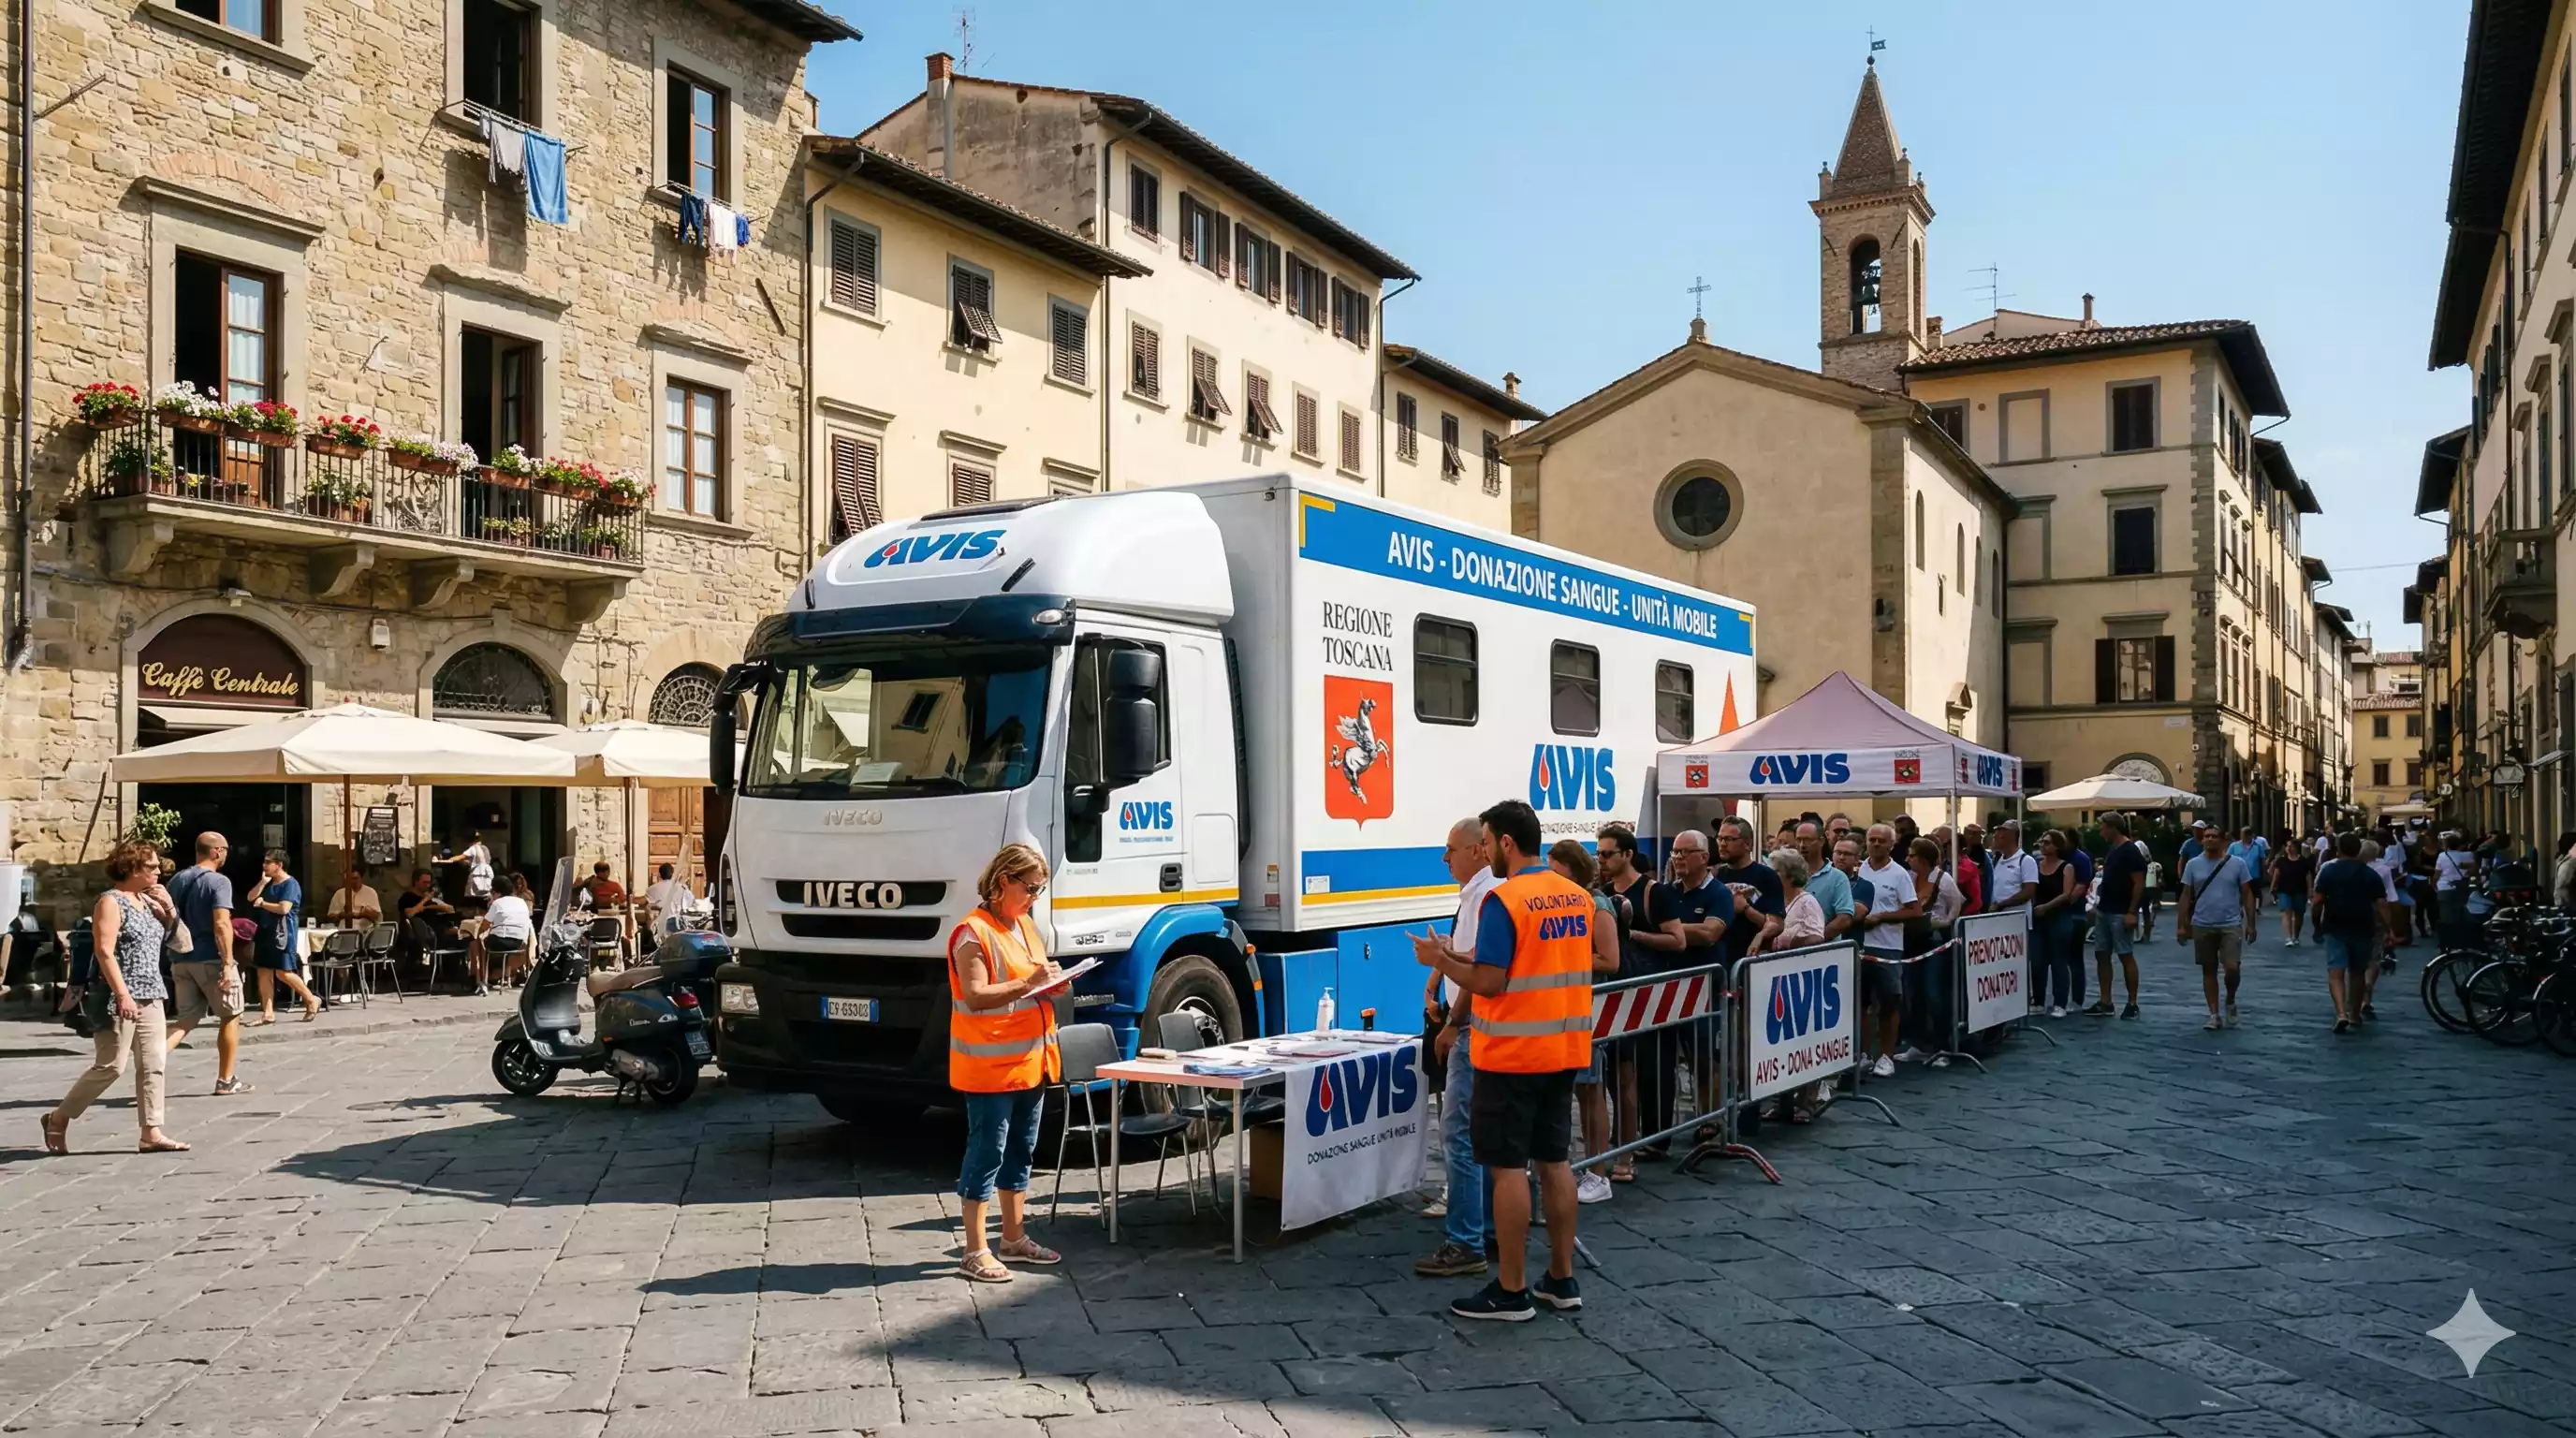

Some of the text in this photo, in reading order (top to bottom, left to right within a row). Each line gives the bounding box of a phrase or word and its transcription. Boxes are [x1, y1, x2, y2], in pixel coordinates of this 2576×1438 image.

[864, 529, 1007, 568] AVIS
[1387, 531, 1435, 574] AVIS
[1452, 547, 1557, 602] DONAZIONE
[1560, 575, 1620, 617] SANGUE
[1632, 594, 1671, 629] UNITÀ
[1673, 604, 1718, 639] MOBILE
[1323, 601, 1393, 638] REGIONE
[1323, 637, 1393, 671] TOSCANA
[142, 662, 299, 697] Caffè Centrale
[1529, 743, 1617, 813] AVIS
[1749, 753, 1851, 785] AVIS
[1976, 754, 2003, 787] AVIS
[823, 809, 884, 827] IVECO
[1119, 800, 1174, 830] AVIS
[803, 881, 903, 910] IVECO
[1539, 914, 1588, 941] AVIS
[1766, 963, 1841, 1046] AVIS
[1756, 1057, 1779, 1086] AVIS
[1788, 1047, 1813, 1076] DONA
[1816, 1035, 1850, 1066] SANGUE
[1305, 1045, 1418, 1137] AVIS
